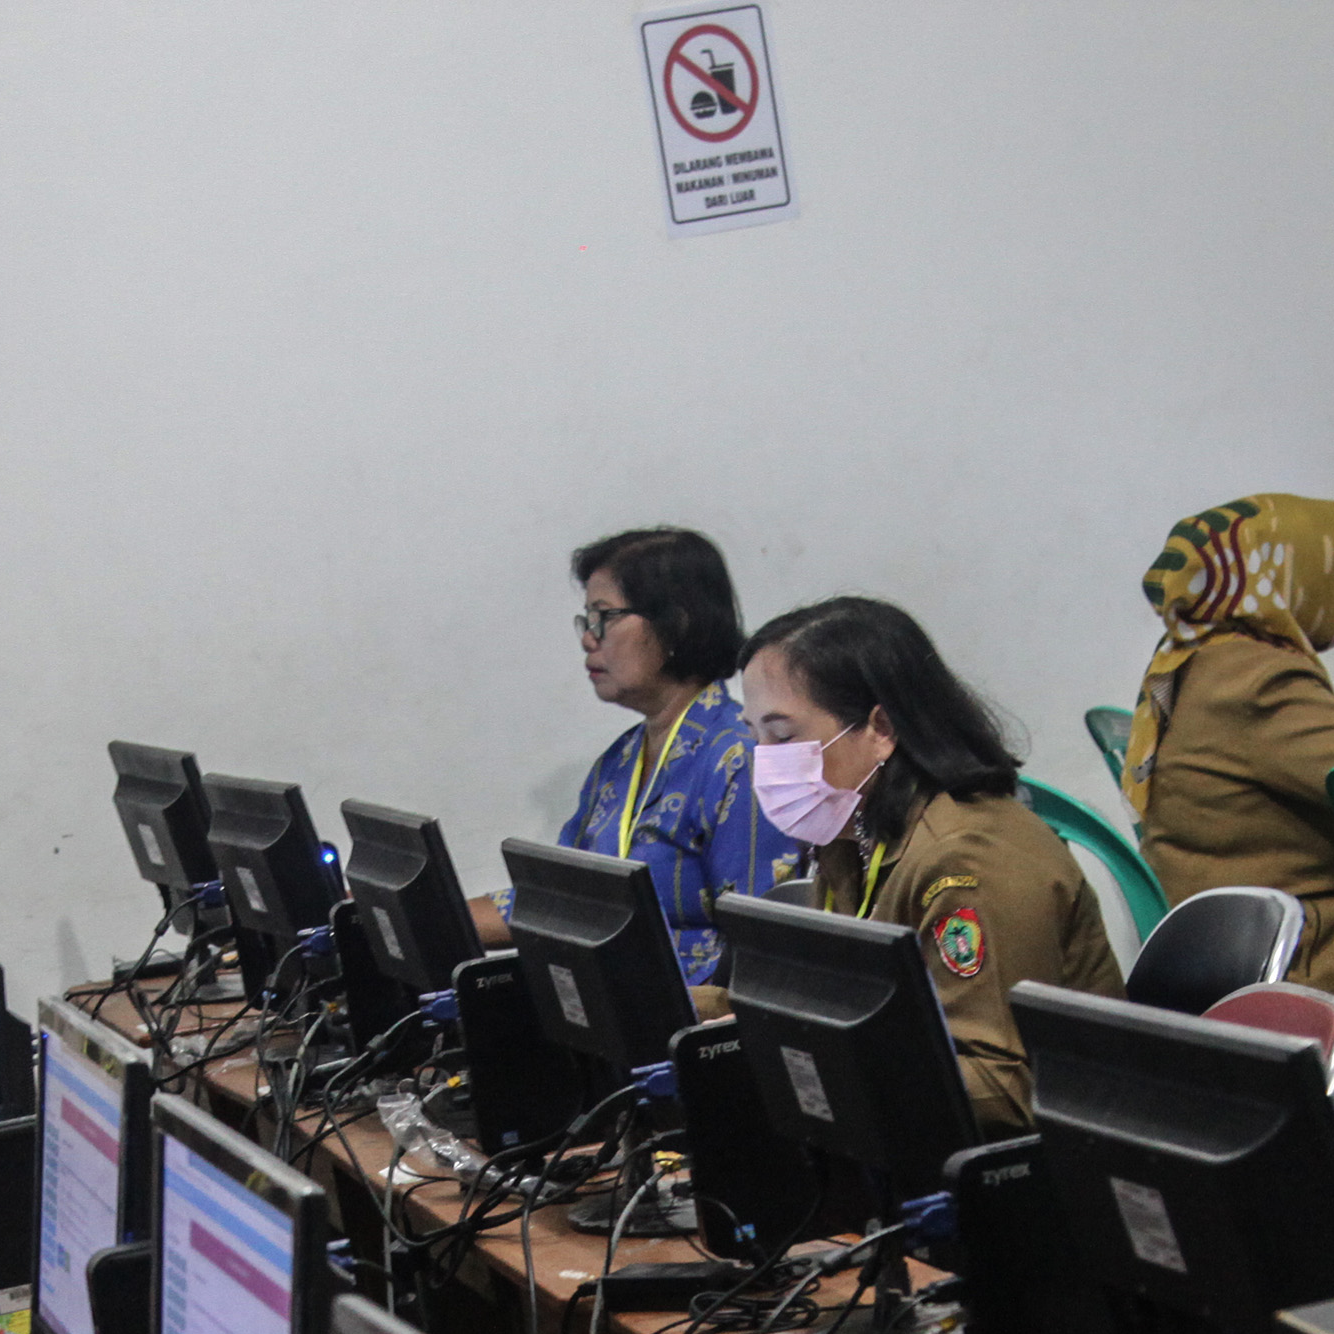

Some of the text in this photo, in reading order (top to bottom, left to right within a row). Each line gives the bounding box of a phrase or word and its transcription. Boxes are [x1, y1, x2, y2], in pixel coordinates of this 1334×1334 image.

[674, 147, 774, 174] DILARANG MEMBAWA
[676, 167, 777, 193] MAKANAN MINUMAN
[705, 189, 754, 208] DARI LUAR
[475, 971, 514, 990] zyrex
[697, 1039, 742, 1060] zyrex
[982, 1163, 1032, 1186] zyrex
